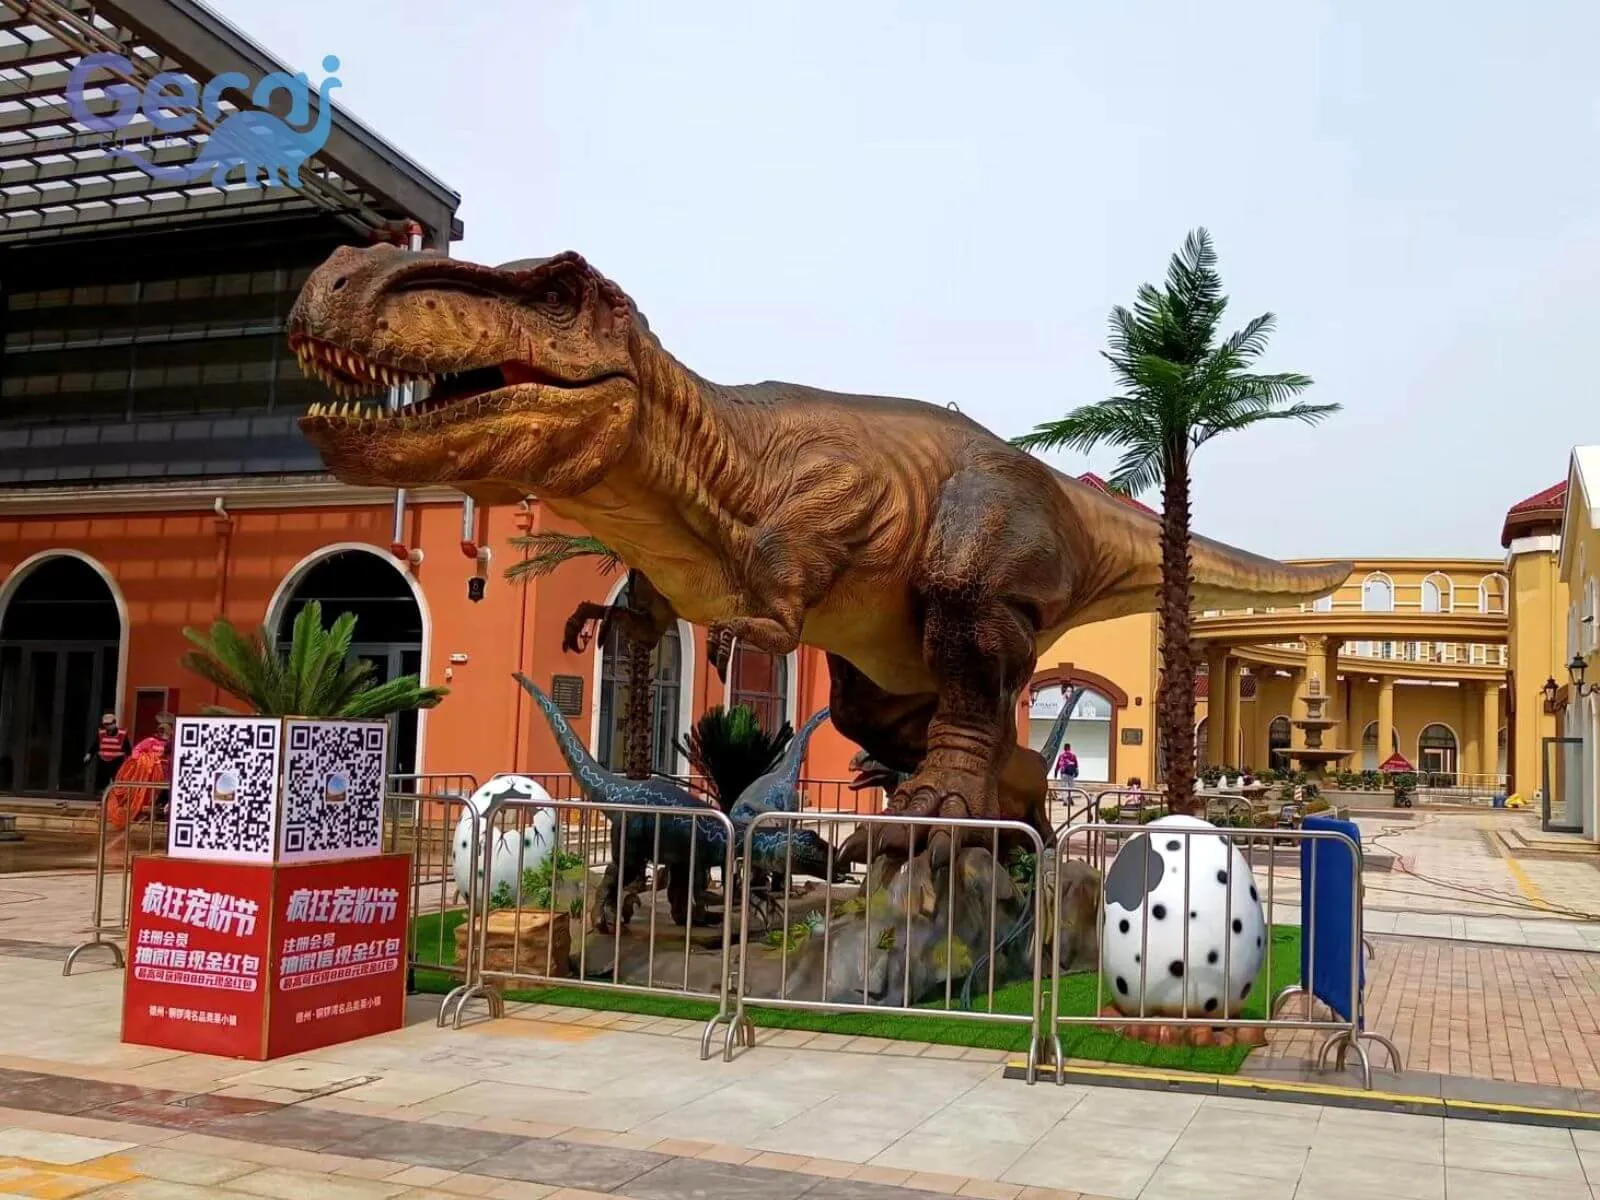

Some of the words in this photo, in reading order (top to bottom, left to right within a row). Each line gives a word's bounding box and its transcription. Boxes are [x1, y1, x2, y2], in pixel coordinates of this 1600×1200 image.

[142, 882, 258, 937] 疯狂宠粉节
[286, 887, 399, 924] 疯狂宠粉节
[138, 928, 189, 947] 注册会员
[282, 932, 336, 954] 注册会员
[135, 946, 260, 977] 抽微信现金红包
[279, 938, 401, 976] 抽微信现金红包
